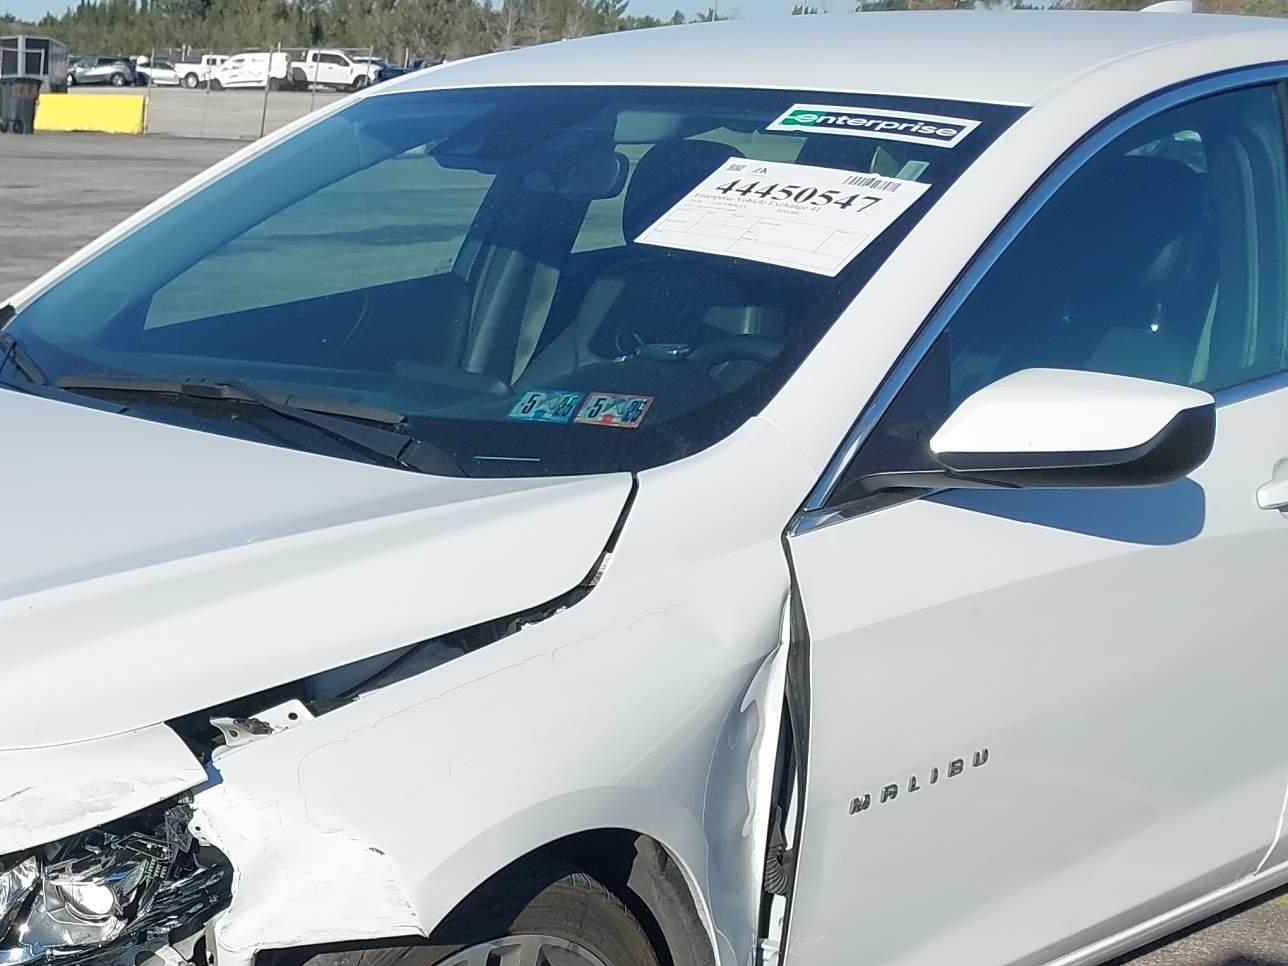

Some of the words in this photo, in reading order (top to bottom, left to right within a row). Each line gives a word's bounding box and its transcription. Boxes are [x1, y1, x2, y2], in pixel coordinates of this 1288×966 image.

[795, 112, 959, 138] enterprise
[715, 179, 883, 213] 44450547
[849, 748, 989, 816] MALIBU
